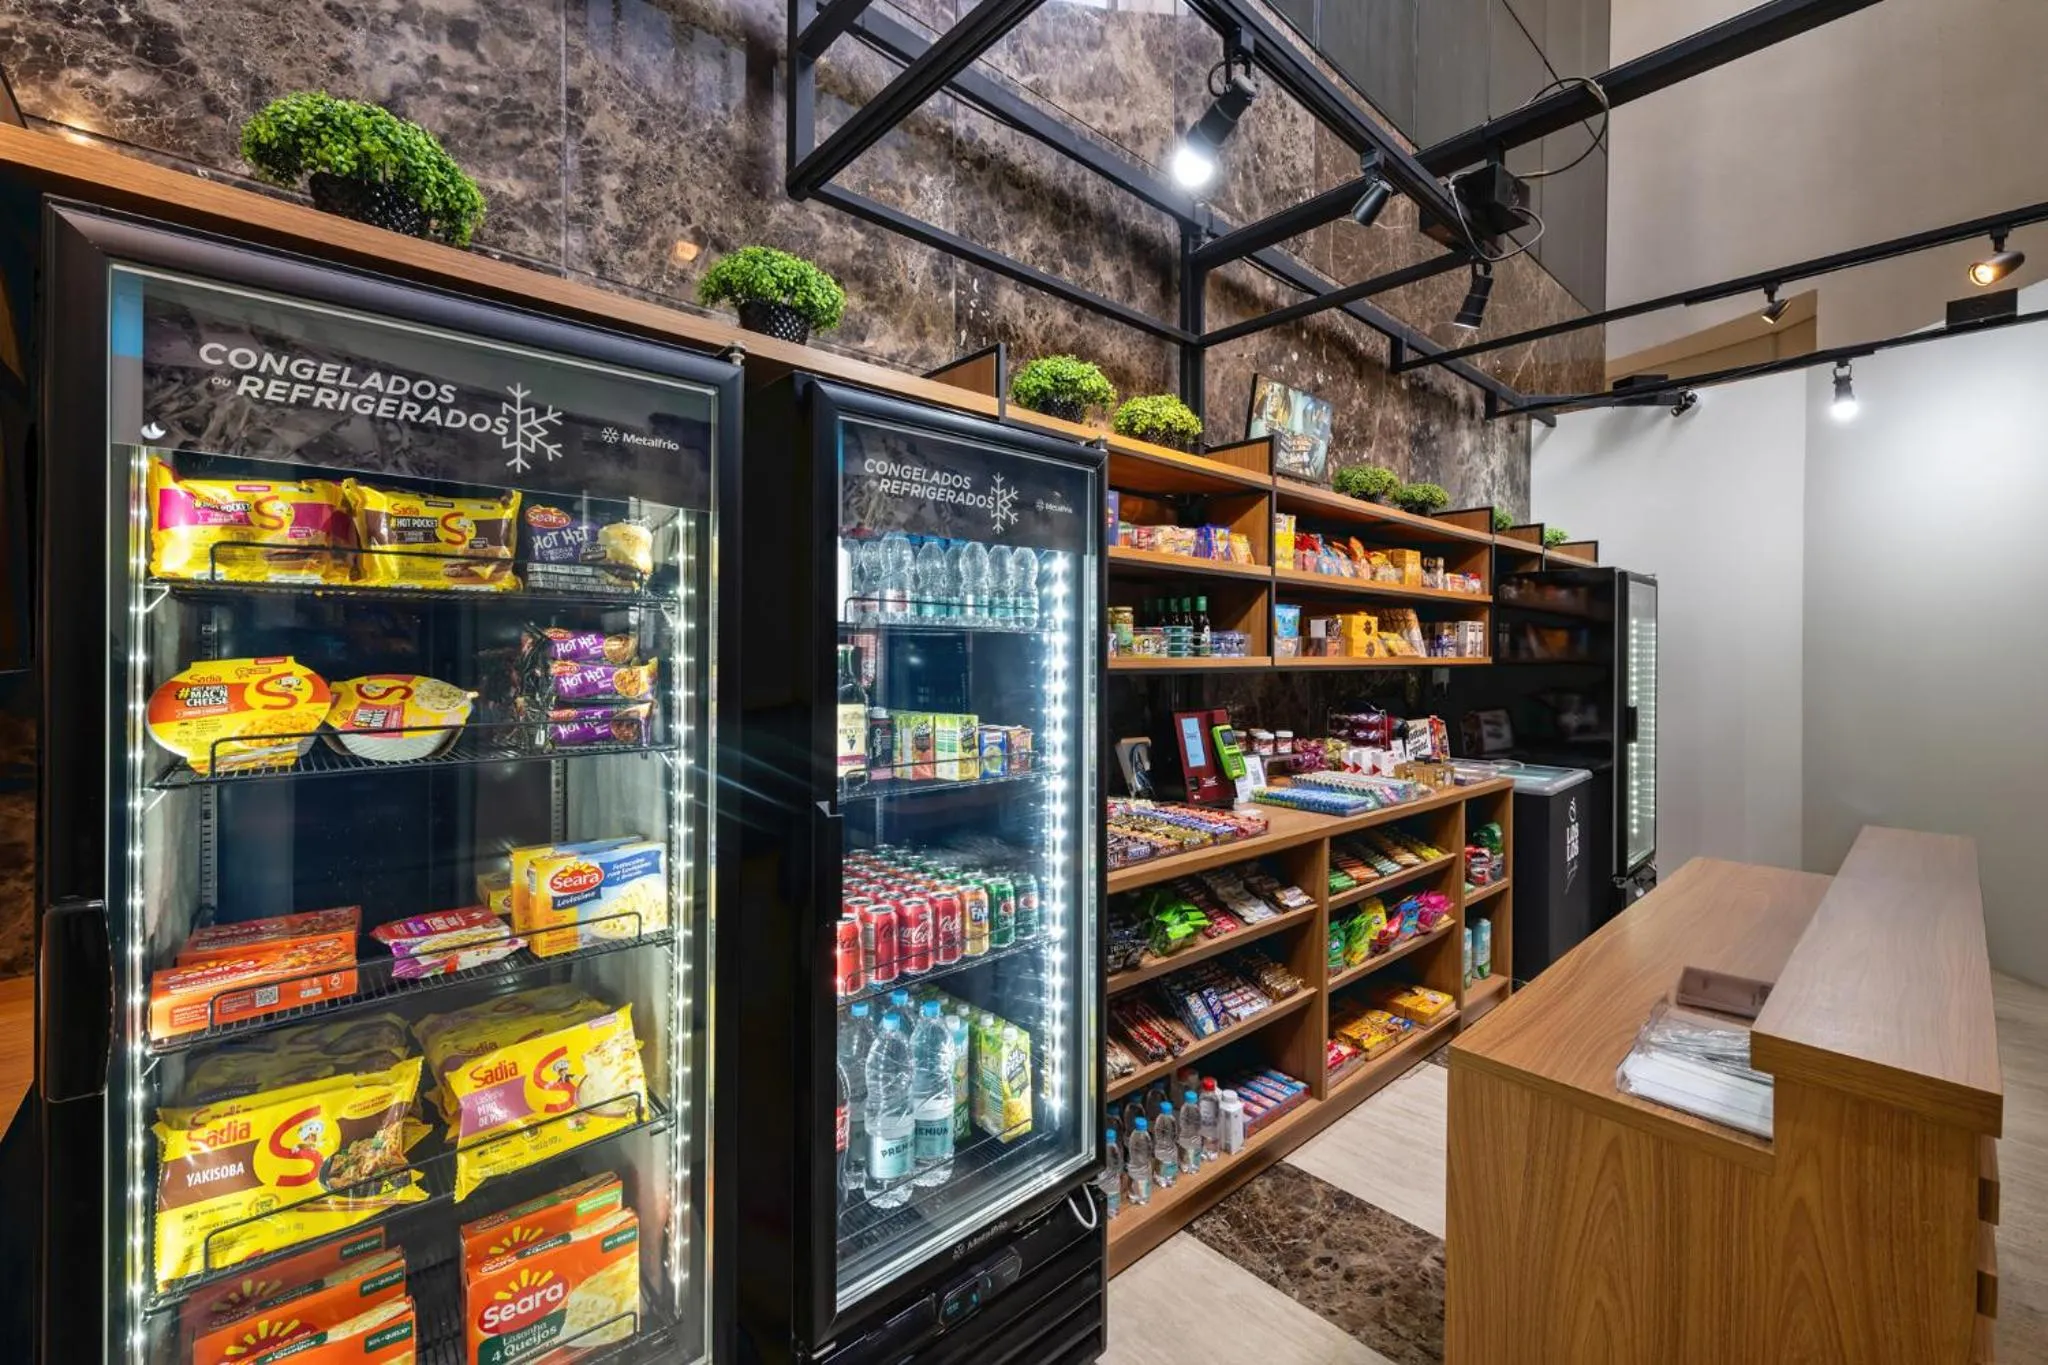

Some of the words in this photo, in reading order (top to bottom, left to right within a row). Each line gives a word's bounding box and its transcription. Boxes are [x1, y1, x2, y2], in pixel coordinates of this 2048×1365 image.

[199, 342, 458, 404] CONGELADOS
[211, 376, 232, 387] OU
[236, 375, 511, 436] REFRIGERADOS
[622, 432, 680, 452] Metalfrio
[863, 458, 972, 490] CONGELADOS
[878, 478, 995, 510] REFRIGERADOS
[532, 531, 559, 557] HOT
[556, 641, 577, 659] HOT
[560, 673, 583, 693] HOT
[185, 697, 228, 708] CHEESE
[552, 872, 600, 889] Seara
[469, 1060, 518, 1088] Sadia
[187, 1120, 251, 1152] Sadia
[186, 1162, 246, 1188] YAKISOBA
[483, 1282, 564, 1329] Seara
[504, 1325, 557, 1357] Queijos
